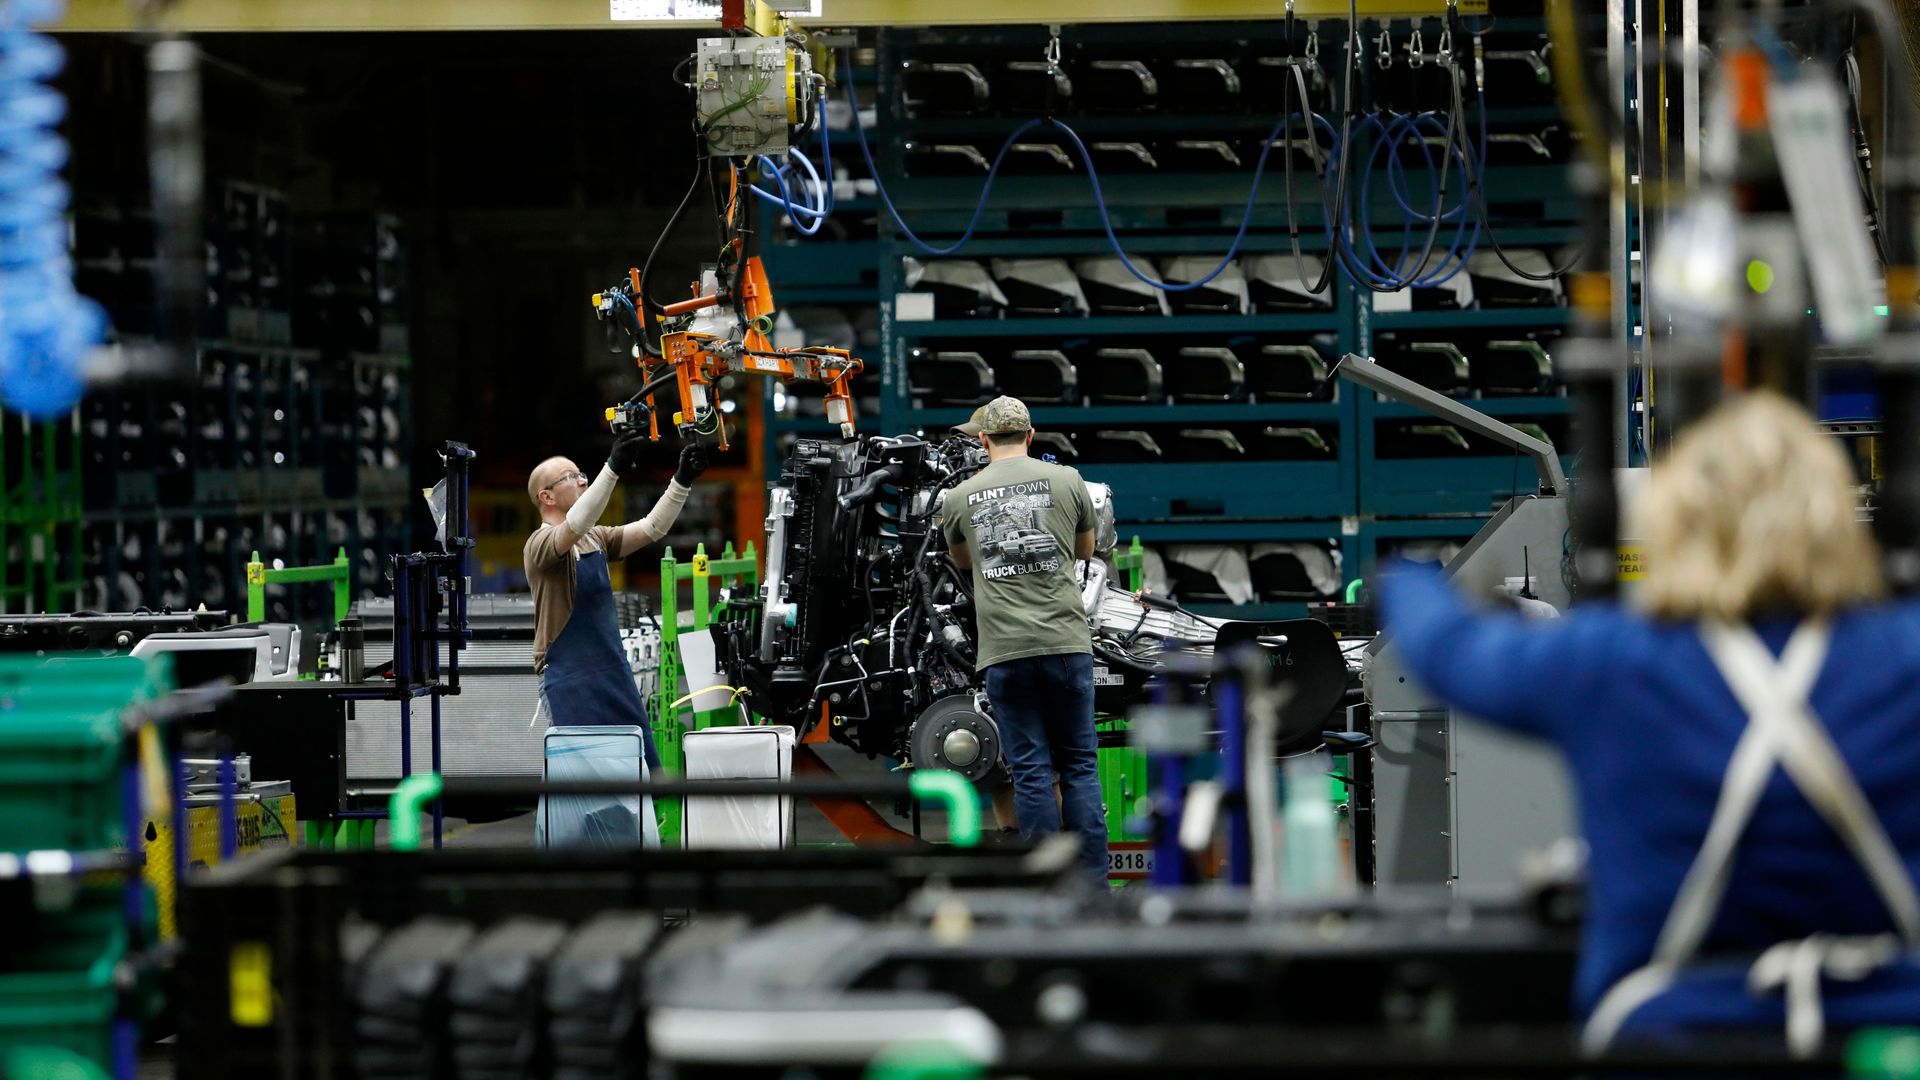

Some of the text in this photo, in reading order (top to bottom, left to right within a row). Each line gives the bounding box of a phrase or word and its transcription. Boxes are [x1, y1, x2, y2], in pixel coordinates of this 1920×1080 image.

[968, 480, 1050, 505] FLINT TOWN
[698, 560, 706, 572] 2
[982, 560, 1059, 579] TRUCK BUILDERS
